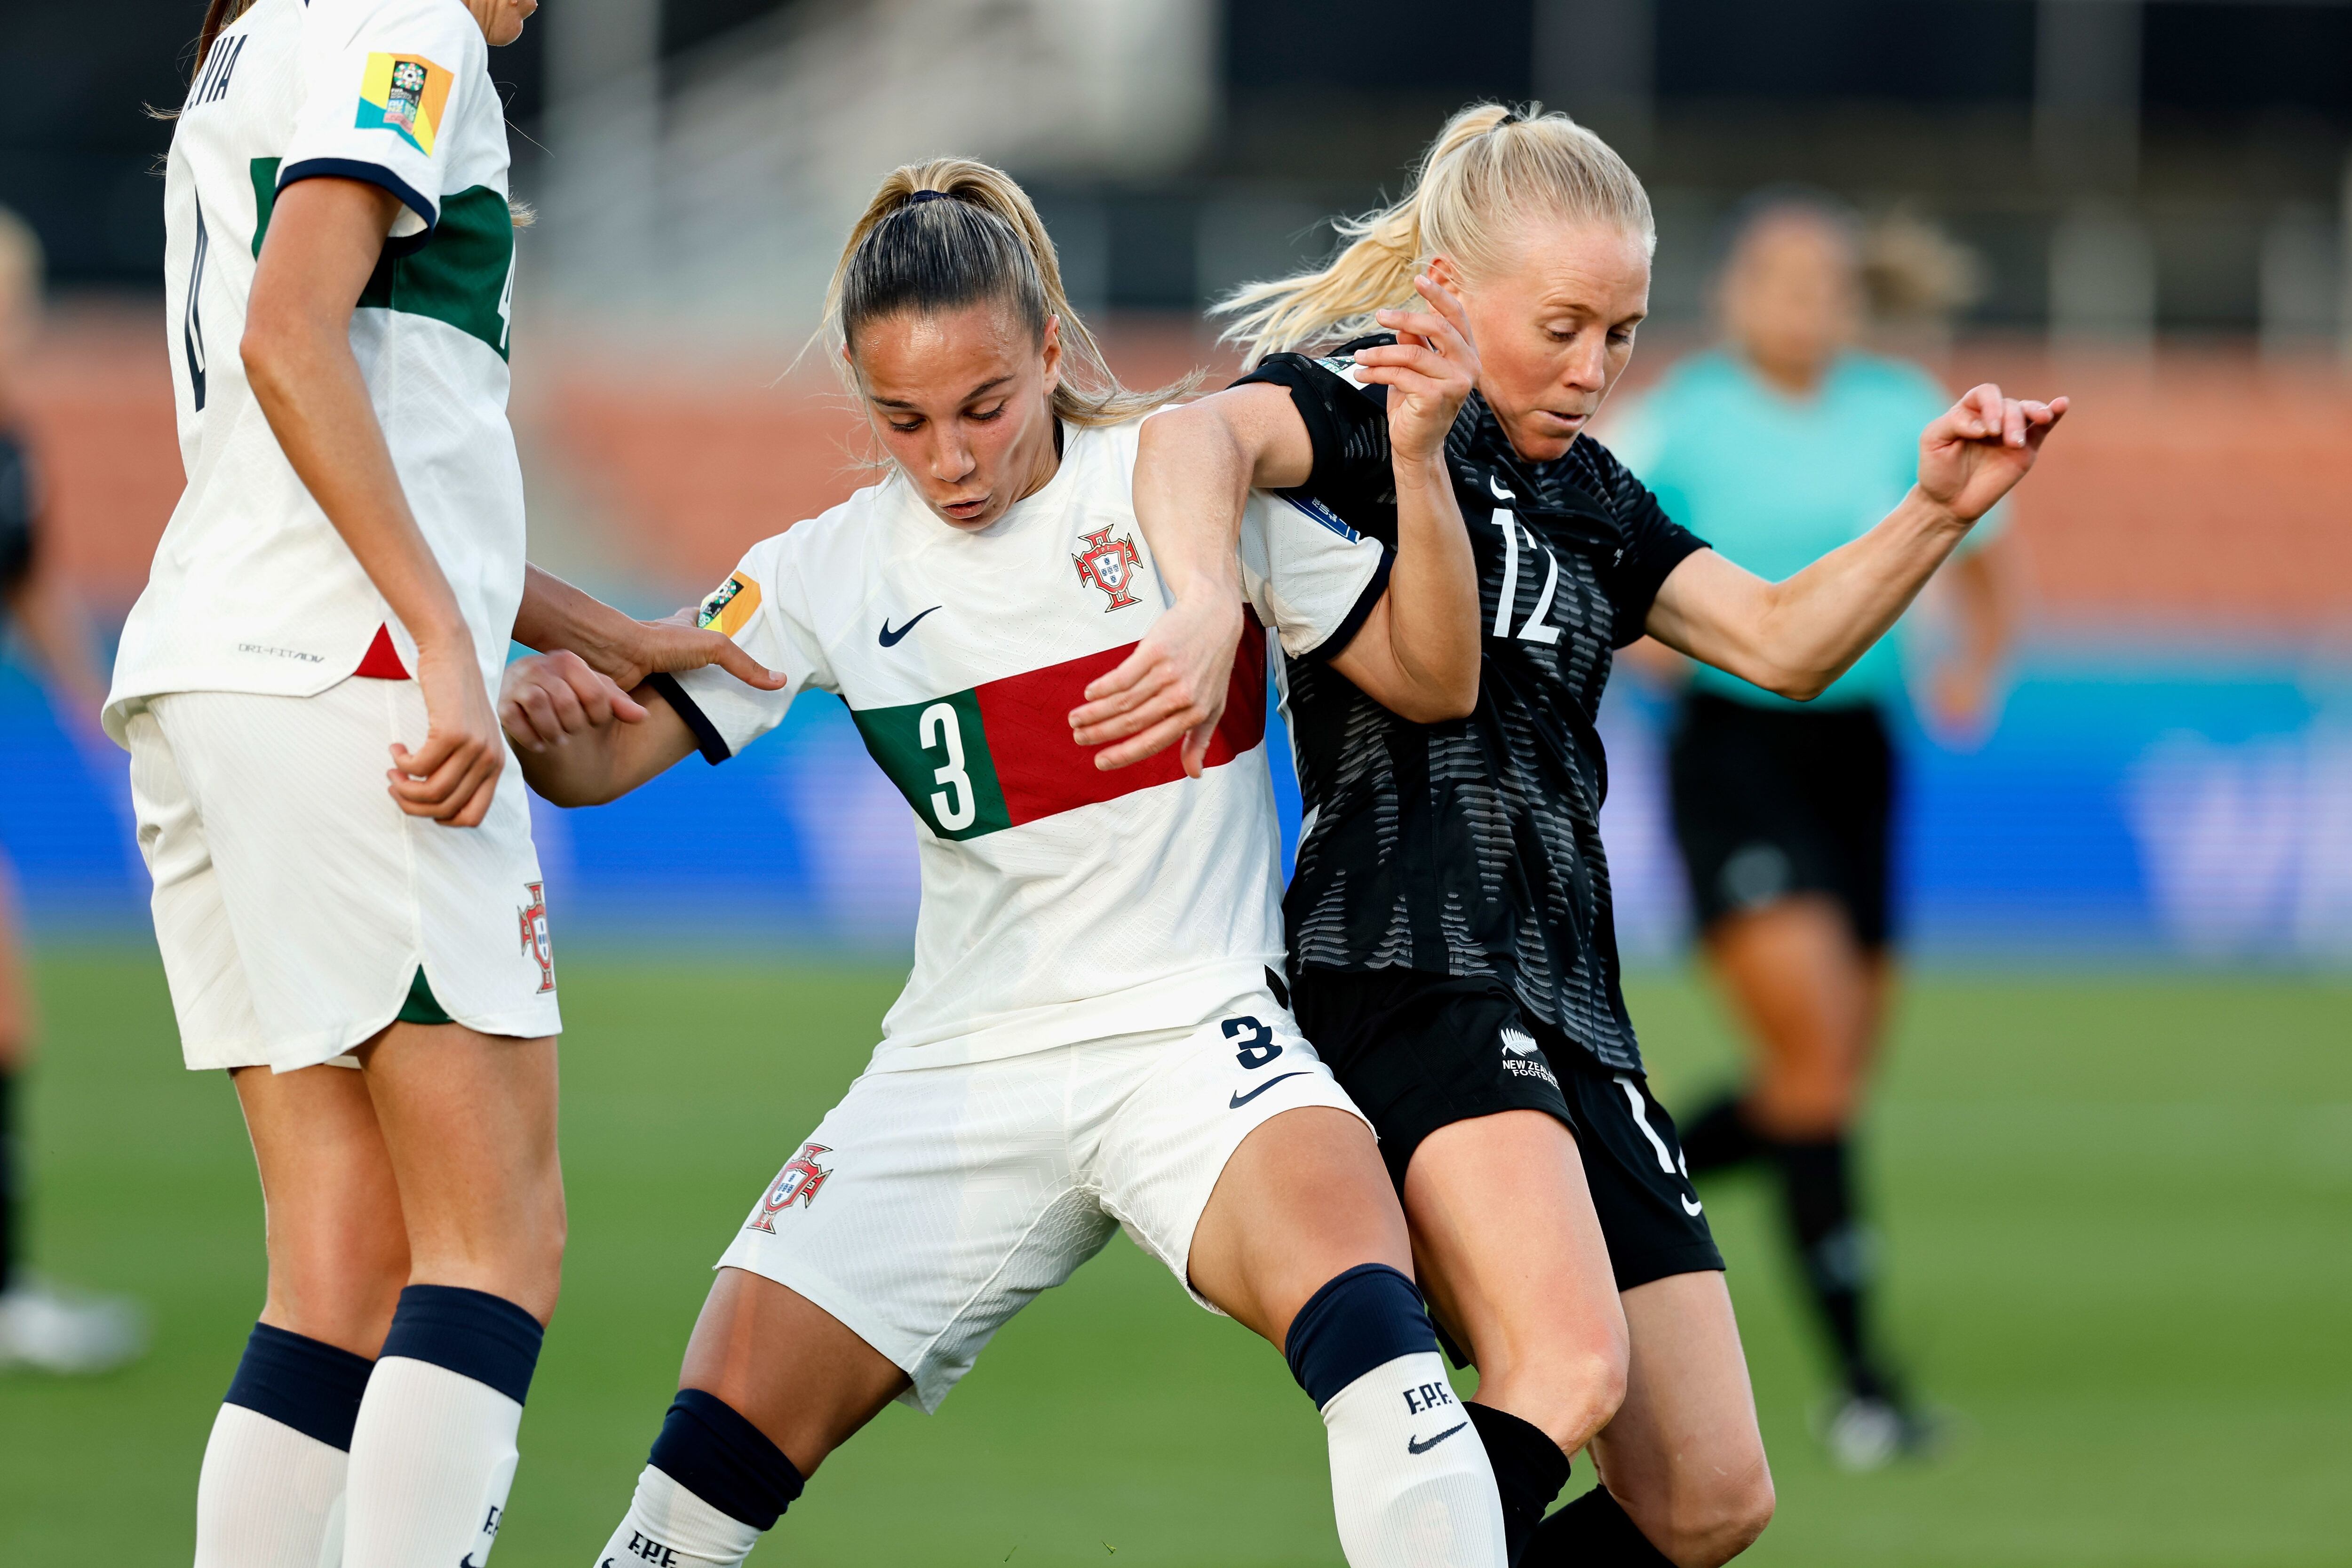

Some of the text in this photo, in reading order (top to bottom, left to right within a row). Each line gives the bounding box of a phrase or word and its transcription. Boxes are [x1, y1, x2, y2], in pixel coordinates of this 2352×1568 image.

[1491, 508, 1561, 645] 12
[919, 703, 976, 831] 3
[1221, 1016, 1283, 1070] 3
[1502, 1060, 1558, 1085] NEW ZEALAN
[1512, 1069, 1560, 1090] FOOTBALL
[1613, 1072, 1689, 1179] 1
[1403, 1382, 1453, 1415] F.P.F.
[628, 1530, 681, 1568] F.P.F
